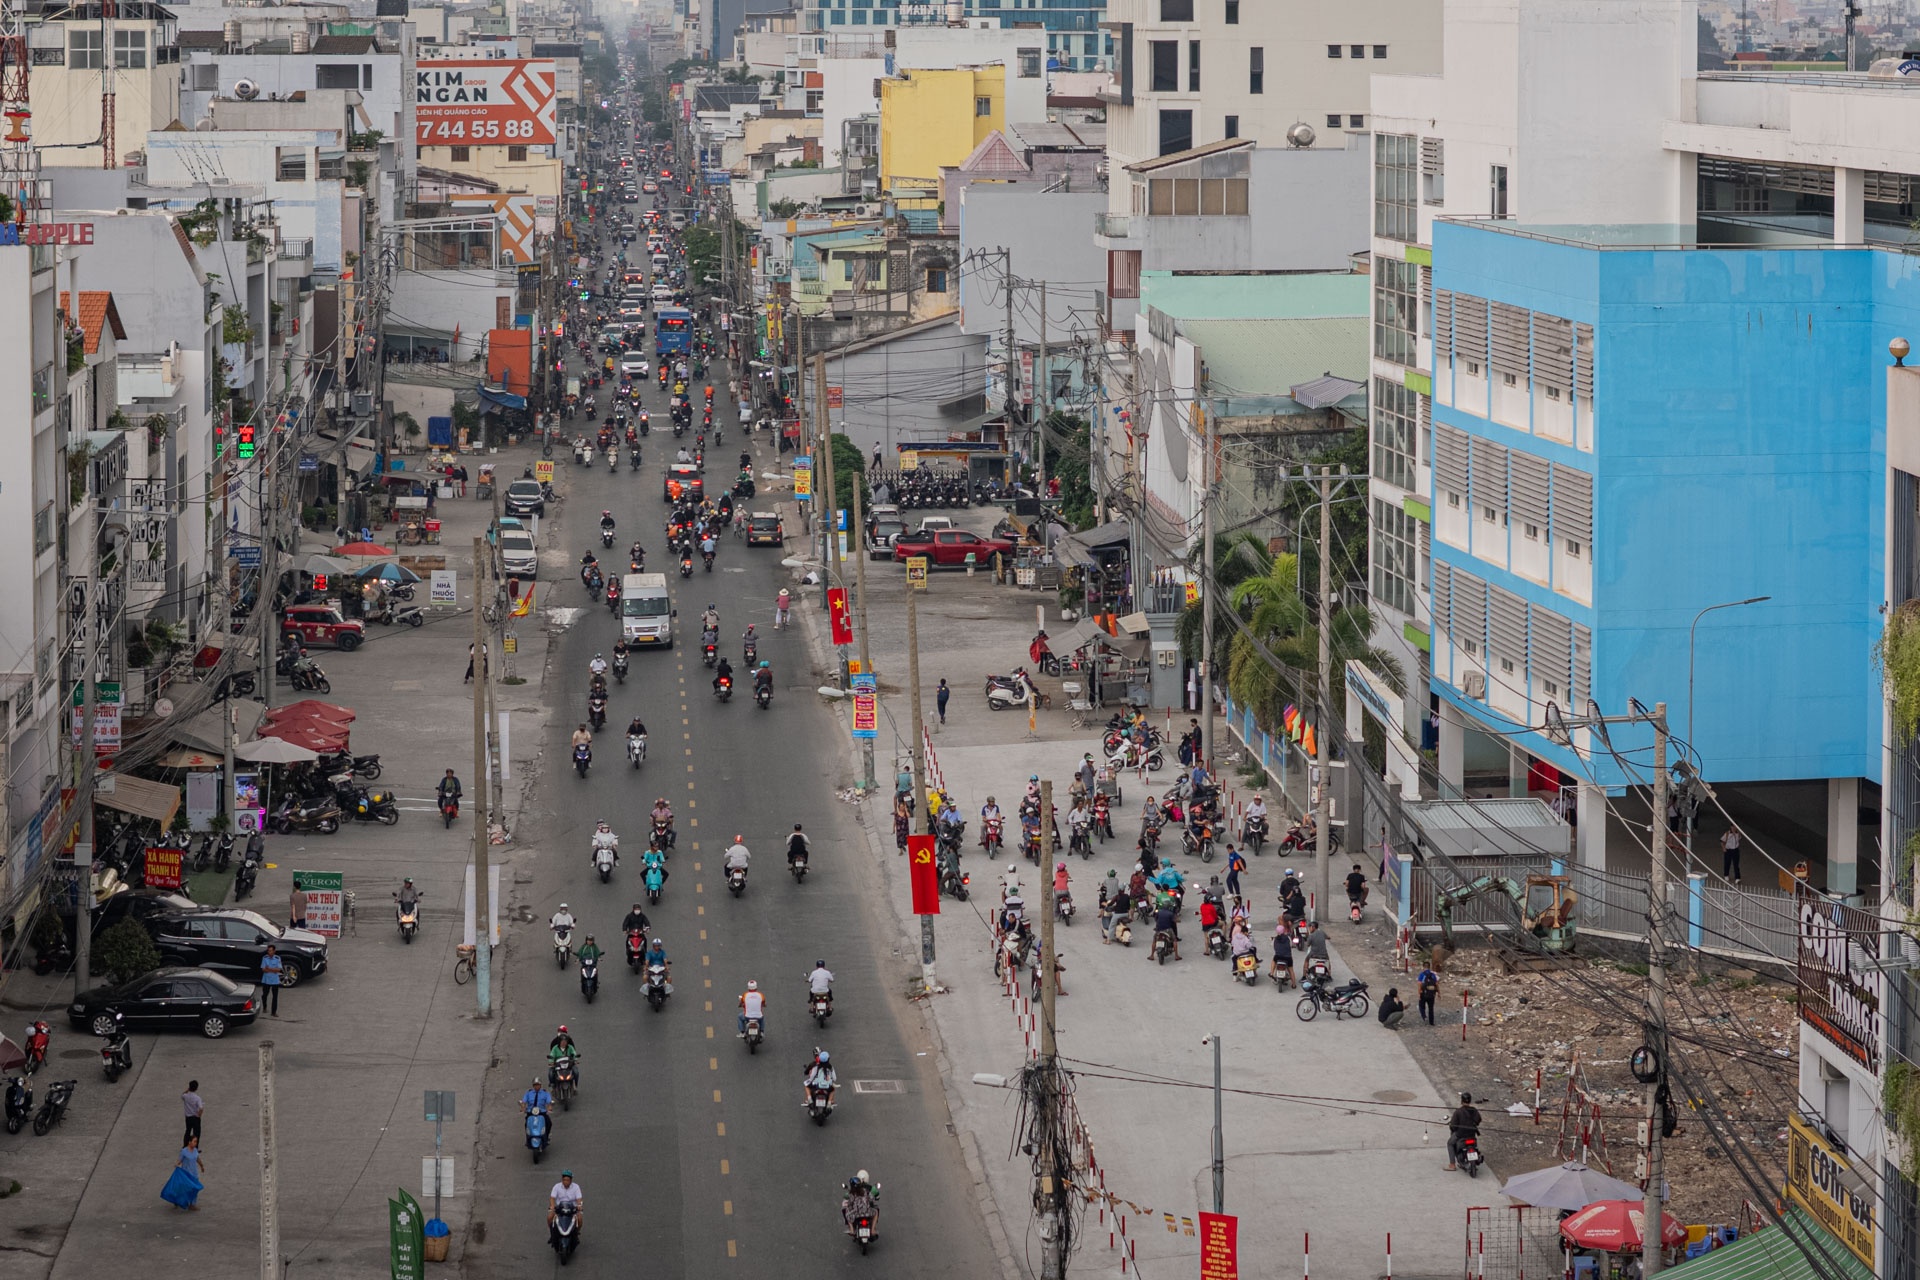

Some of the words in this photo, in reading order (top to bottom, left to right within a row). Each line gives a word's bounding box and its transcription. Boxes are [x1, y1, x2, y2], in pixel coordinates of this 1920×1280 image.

[417, 72, 462, 86] KIM
[417, 88, 487, 102] NGAN
[471, 120, 499, 138] 55
[505, 119, 534, 138] 88
[26, 223, 93, 245] APPLE
[537, 463, 552, 472] XÔI
[132, 484, 166, 506] GYM
[131, 520, 166, 542] YOGA
[131, 560, 166, 582] BOXING
[73, 653, 110, 678] BONG
[147, 864, 169, 876] THANH
[1810, 1188, 1842, 1232] Singapore
